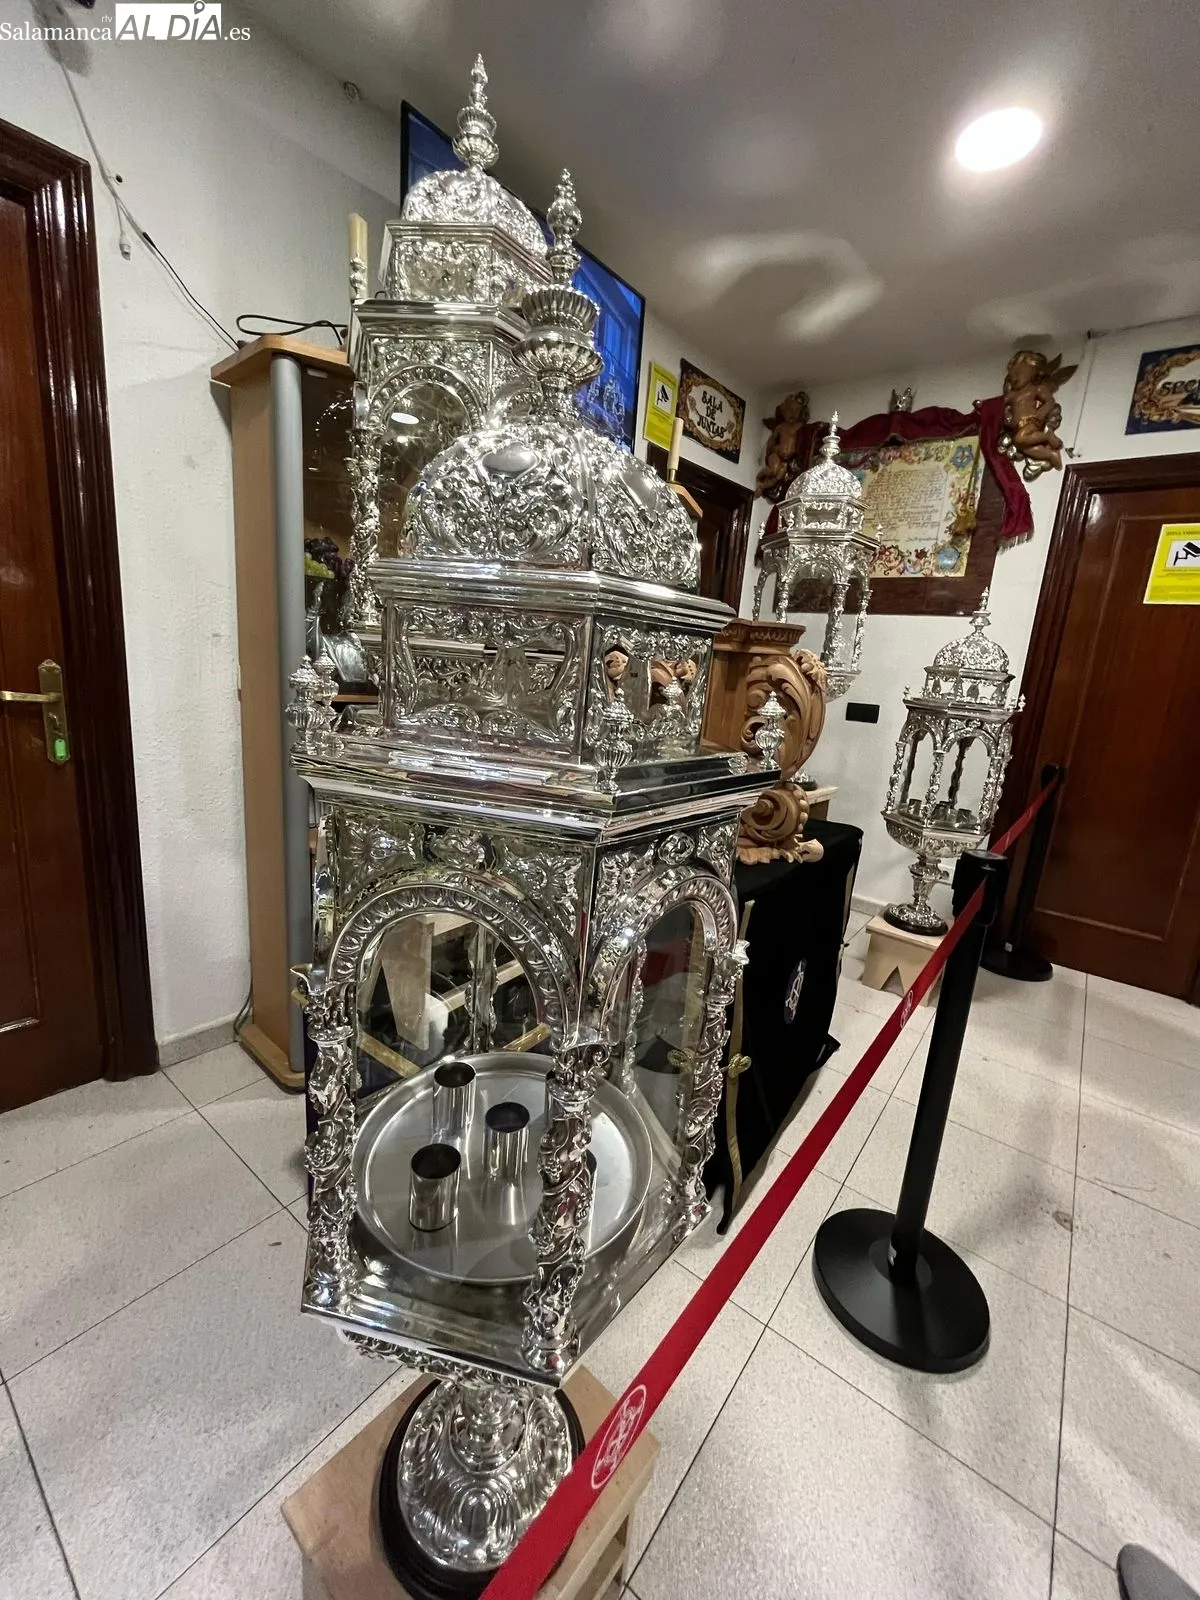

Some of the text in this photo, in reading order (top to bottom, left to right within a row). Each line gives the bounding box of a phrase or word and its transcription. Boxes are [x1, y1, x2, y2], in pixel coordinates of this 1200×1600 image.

[702, 390, 723, 413] SALA
[706, 405, 717, 421] DE
[697, 415, 727, 438] JUNTAS
